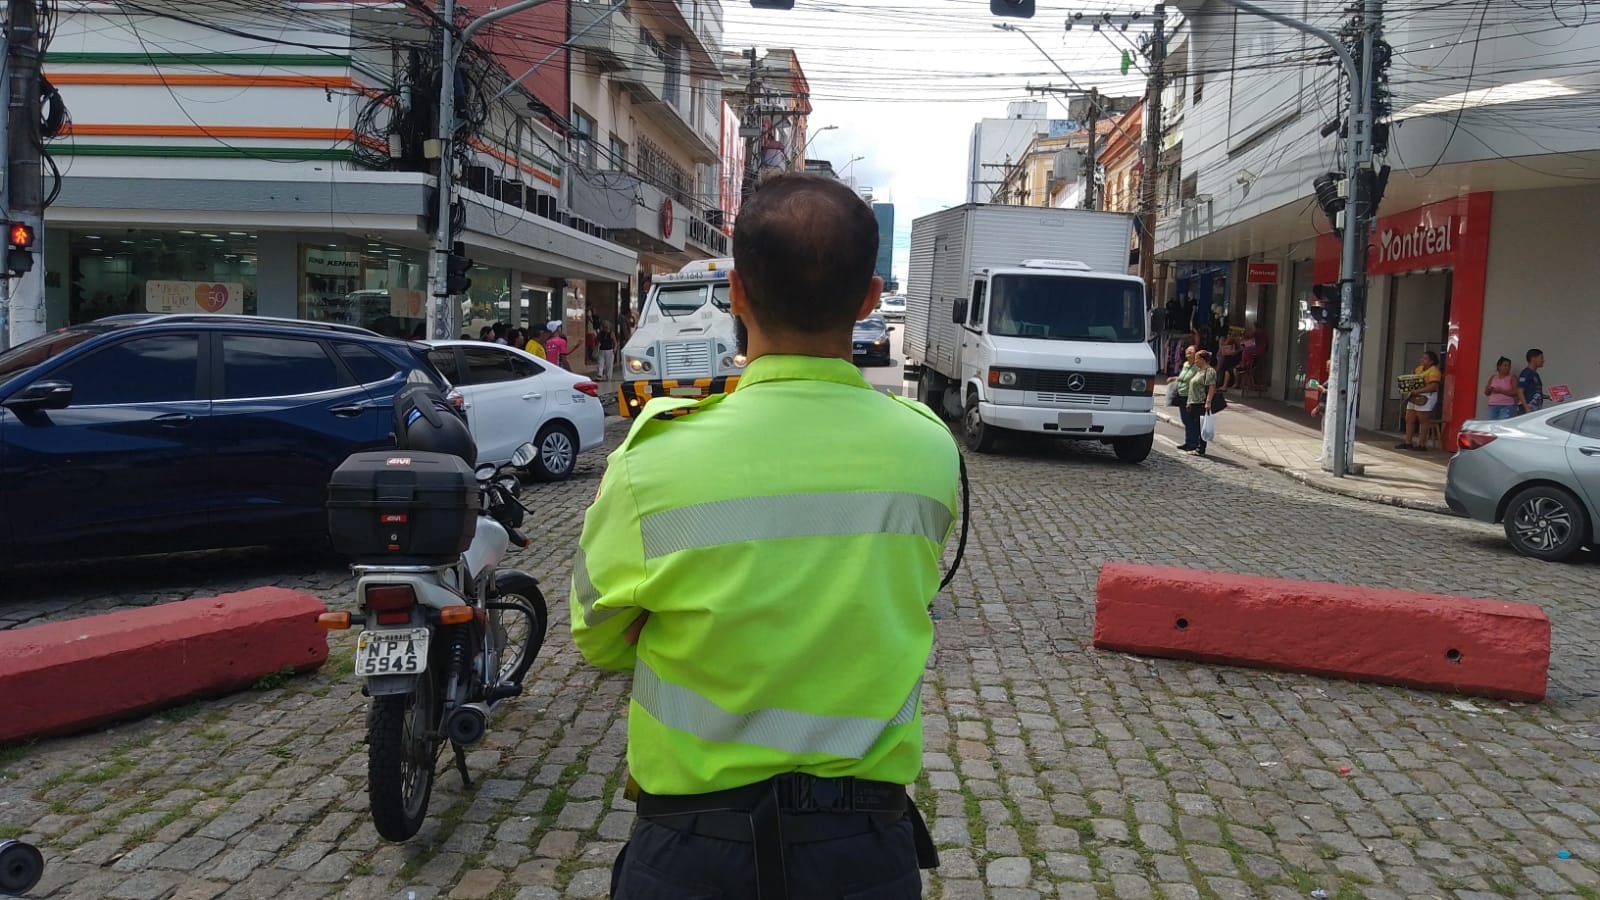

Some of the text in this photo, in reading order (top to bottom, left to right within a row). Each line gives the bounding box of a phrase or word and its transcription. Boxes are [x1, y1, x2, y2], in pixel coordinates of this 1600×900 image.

[1379, 215, 1452, 263] Montreal
[368, 640, 415, 658] NPA
[365, 656, 417, 674] 5945
